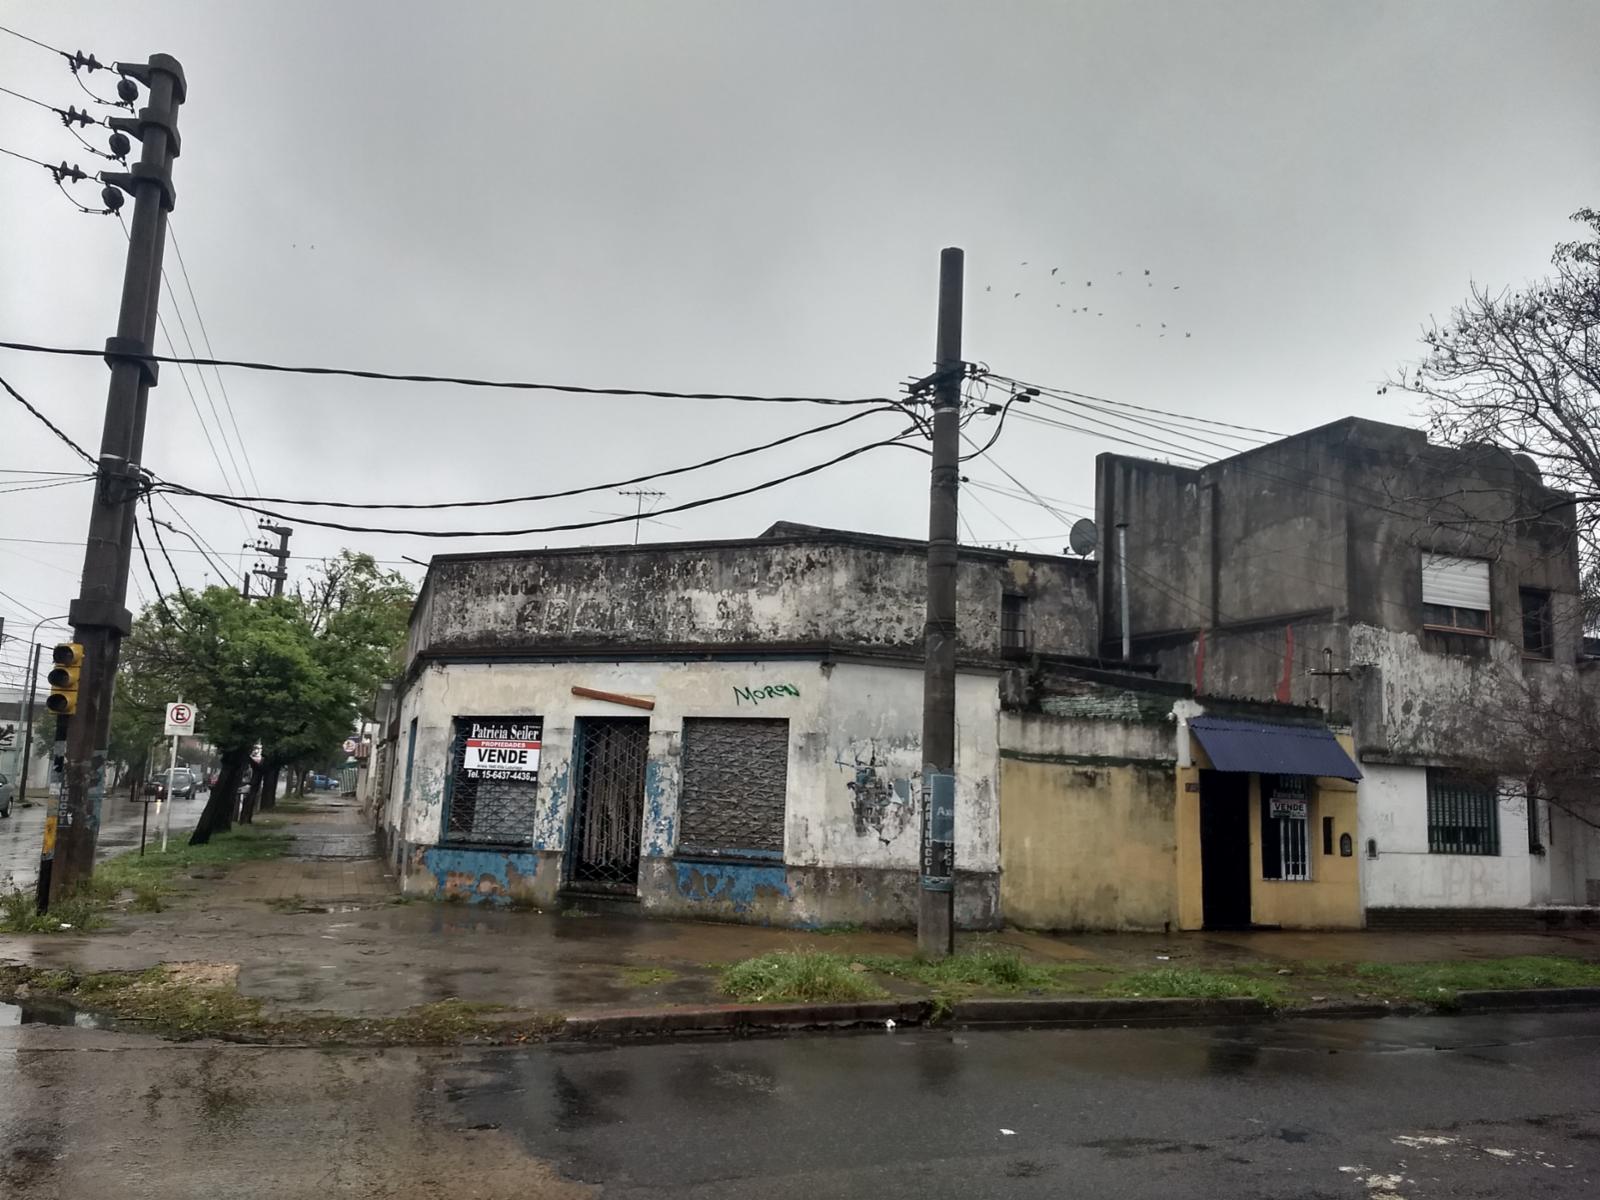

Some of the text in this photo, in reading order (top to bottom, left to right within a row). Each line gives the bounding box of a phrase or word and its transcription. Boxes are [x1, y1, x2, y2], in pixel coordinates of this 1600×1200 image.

[175, 707, 186, 720] E
[471, 723, 540, 740] Patricia Seiler
[478, 749, 528, 764] VENDE
[467, 770, 480, 778] Tel.
[1274, 803, 1304, 811] VENDE
